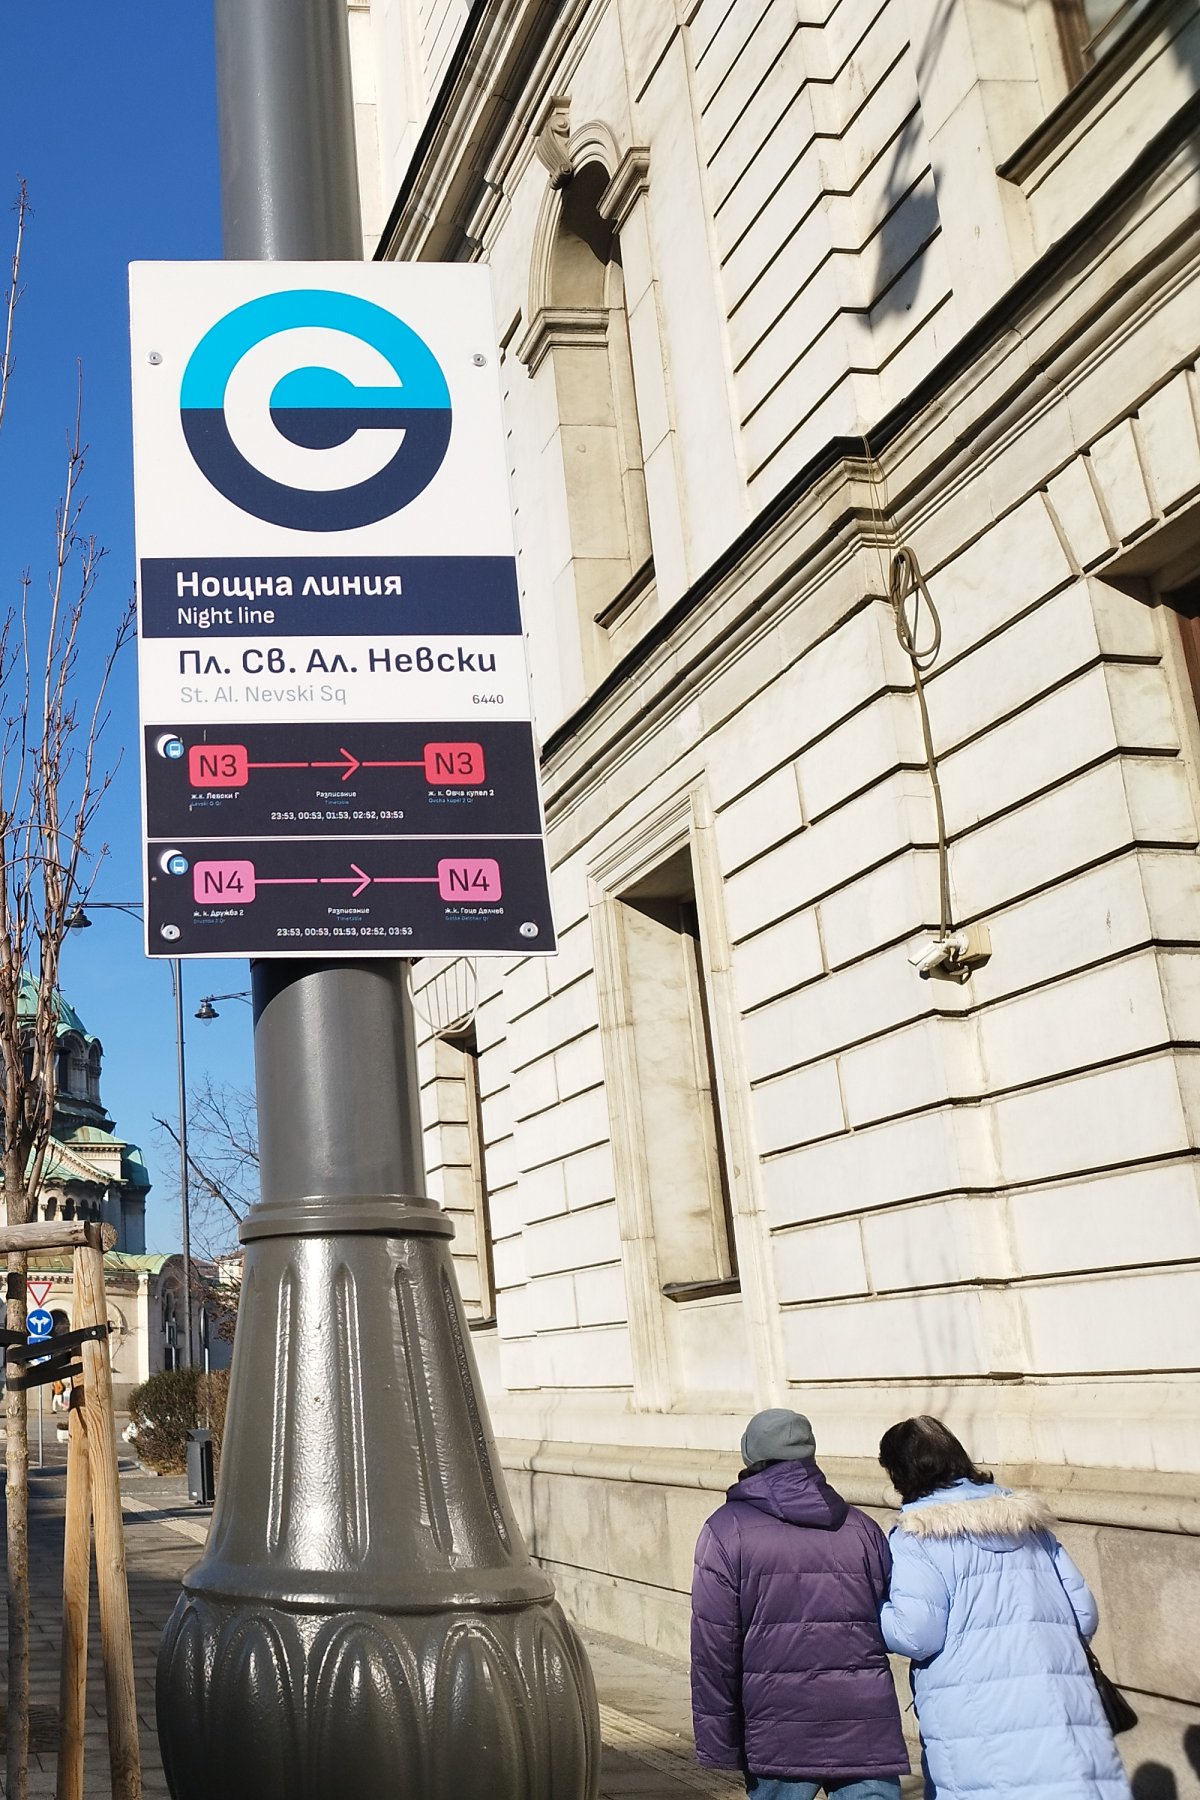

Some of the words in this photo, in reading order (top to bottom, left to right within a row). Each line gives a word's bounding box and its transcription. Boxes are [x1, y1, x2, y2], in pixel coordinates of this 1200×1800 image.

[176, 571, 293, 601] Нощна
[301, 574, 402, 596] линия
[177, 606, 234, 629] Night
[238, 606, 275, 624] line
[179, 649, 231, 675] Пл.
[242, 647, 296, 674] Св.
[305, 648, 358, 673] Ал.
[368, 646, 497, 673] Невски
[180, 686, 209, 704] St.
[214, 685, 238, 703] Al.
[245, 684, 314, 703] Nevski
[320, 684, 347, 706] Sq
[472, 694, 505, 705] 6440
[199, 753, 238, 778] N3
[435, 751, 474, 775] N3
[315, 790, 357, 799] Разписание
[489, 788, 495, 797] 2
[298, 812, 324, 821] 00:53,
[325, 811, 351, 820] 01:53,
[380, 810, 405, 819] 03:53
[203, 870, 245, 895] N4
[448, 868, 491, 892] N4
[327, 907, 370, 915] Разписание
[276, 928, 303, 937] 23:53,
[304, 928, 331, 937] 00:53,
[332, 928, 359, 937] 01:53,
[360, 927, 387, 936] 02:52,
[388, 927, 414, 936] 03:53
